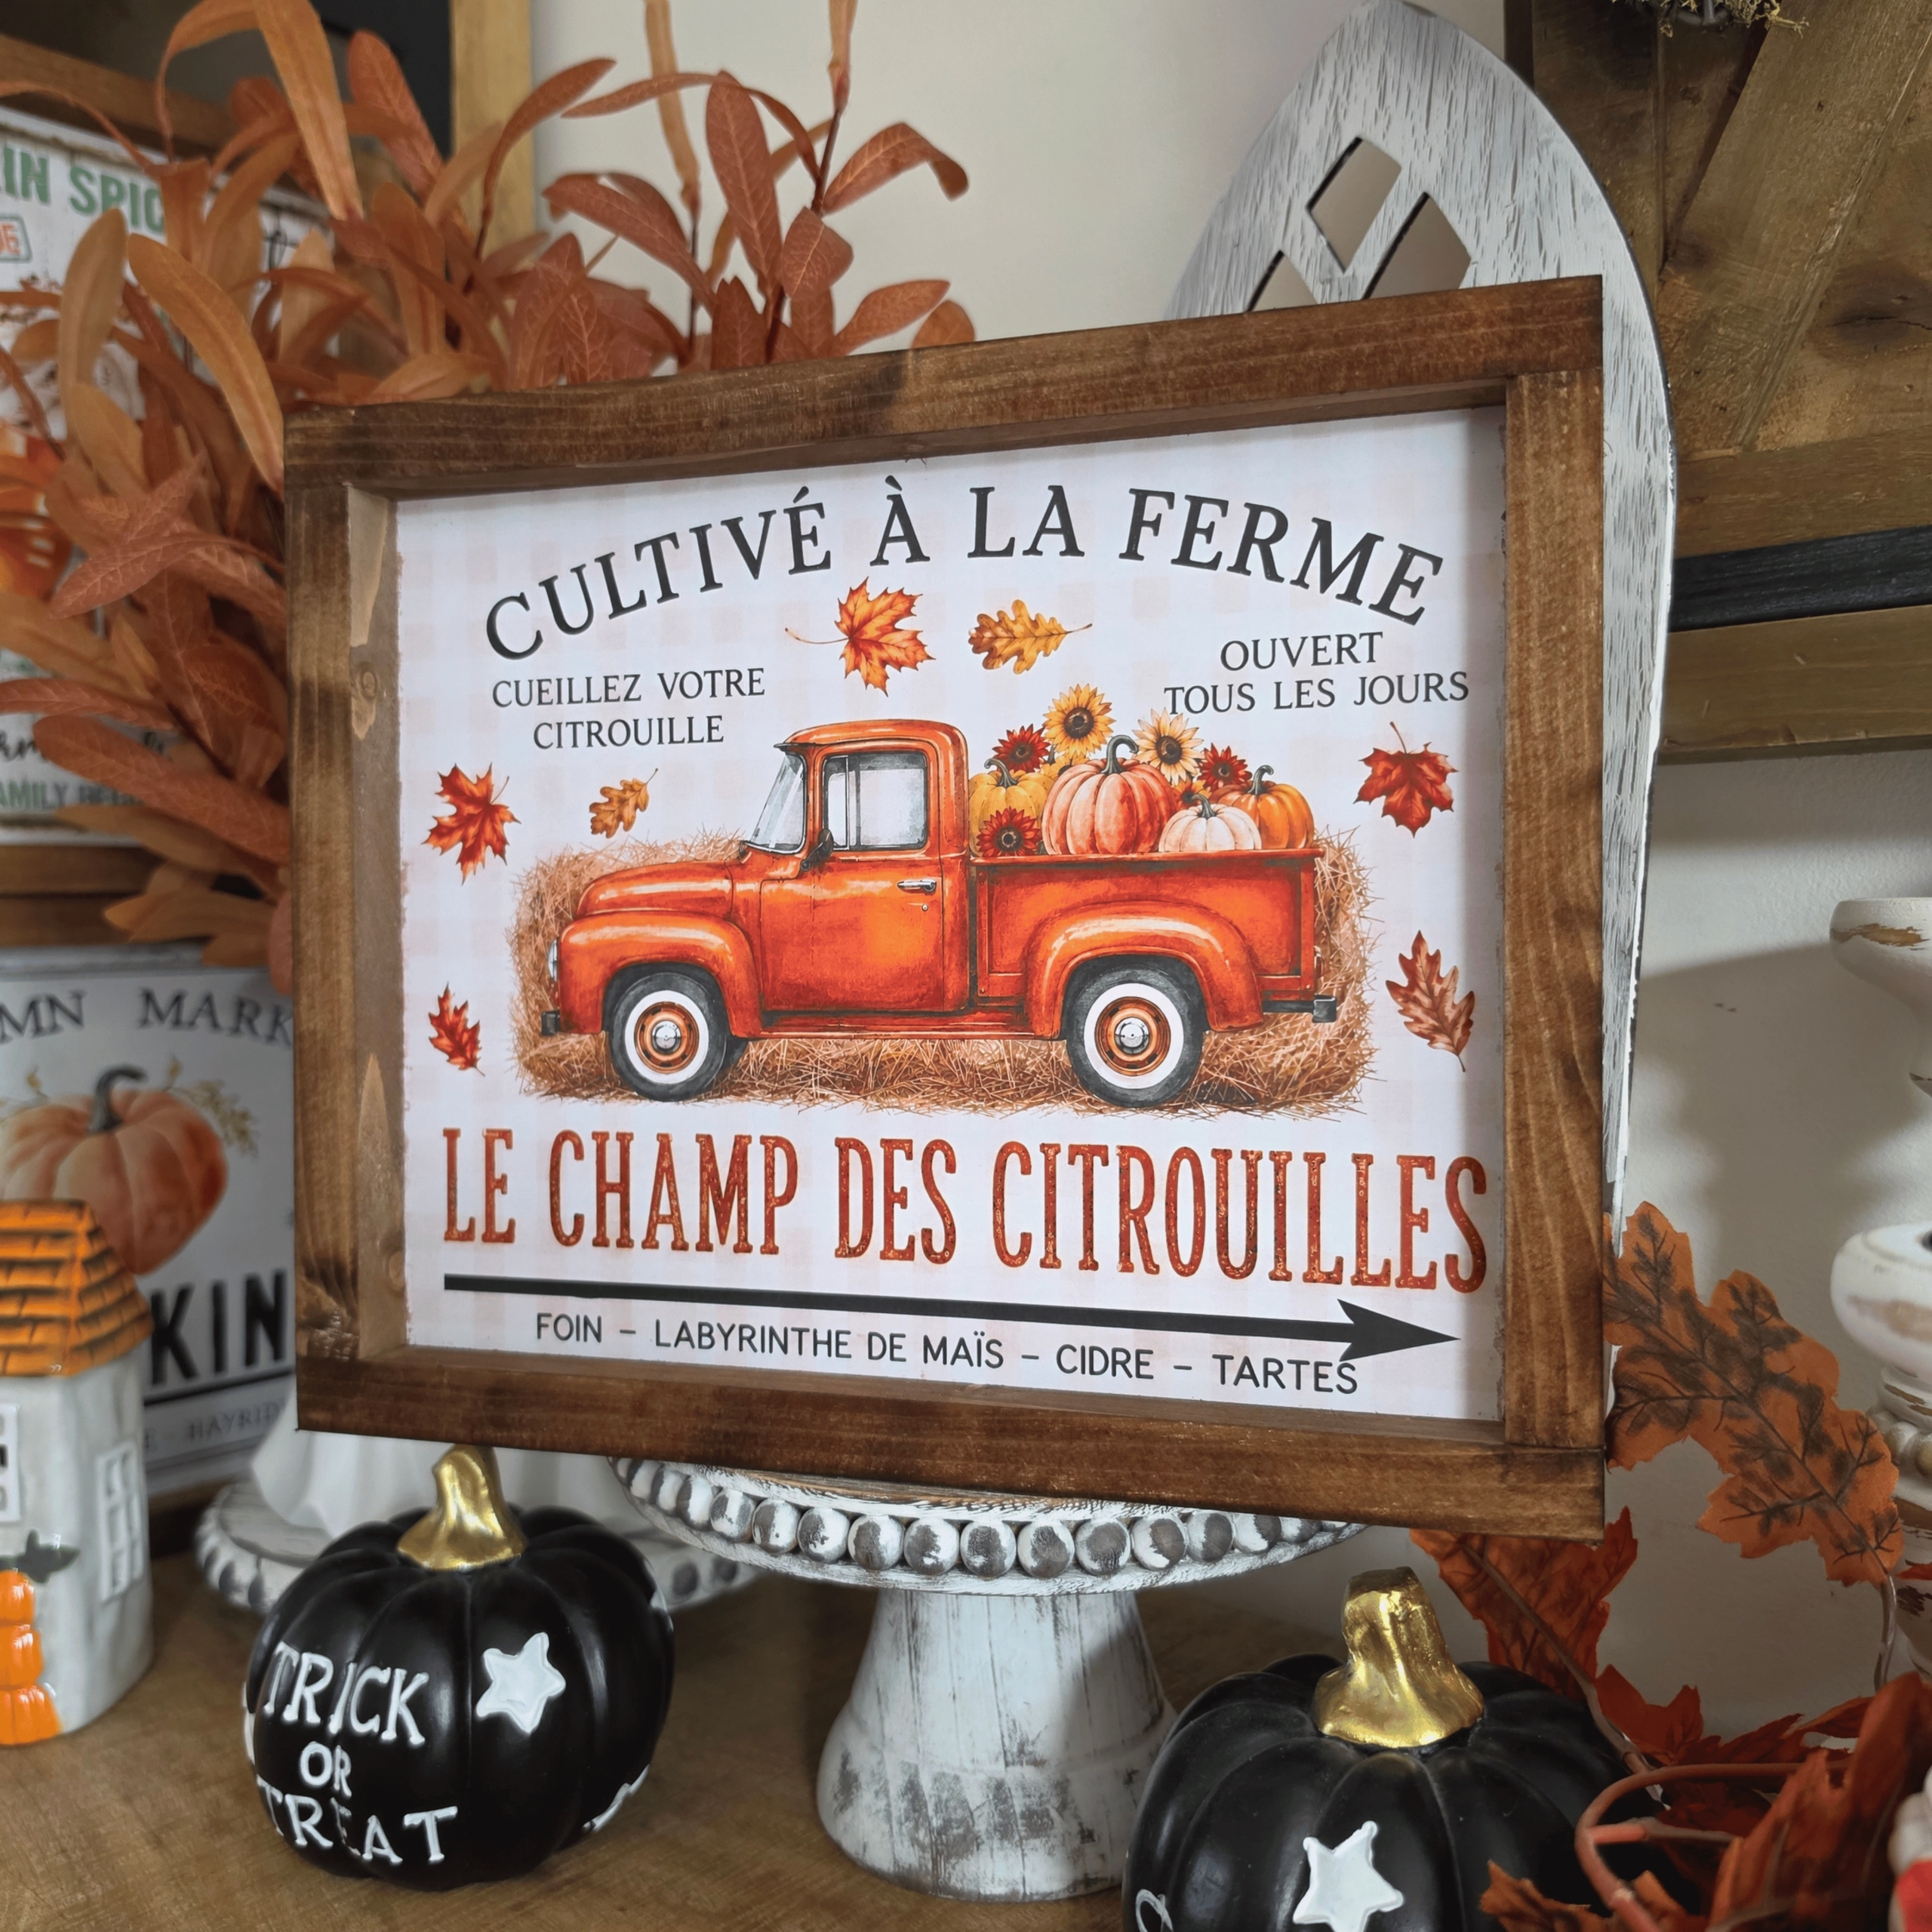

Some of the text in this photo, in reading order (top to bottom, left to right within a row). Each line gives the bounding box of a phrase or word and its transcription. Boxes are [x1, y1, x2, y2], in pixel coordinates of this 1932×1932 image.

[485, 474, 1444, 661] CULTIVÉ À LA FERME
[1220, 631, 1384, 672] OUVERT
[492, 667, 766, 708] CUEILLEZ VOTRE
[1164, 671, 1470, 715] TOUS LES JOURS
[533, 715, 725, 749] CITROUILLE
[443, 1128, 1487, 1294] LE CHAMP DES CITROUILLES
[536, 1312, 603, 1344] FOIN
[654, 1318, 853, 1359] LABYRINTHE
[867, 1331, 907, 1363] DE
[921, 1331, 1004, 1370] MAÏS
[1056, 1343, 1155, 1381] CIDRE
[1212, 1353, 1358, 1395] TARTES
[263, 1641, 429, 1747] TRICK
[300, 1740, 352, 1798] OR
[257, 1773, 458, 1864] TREAT
